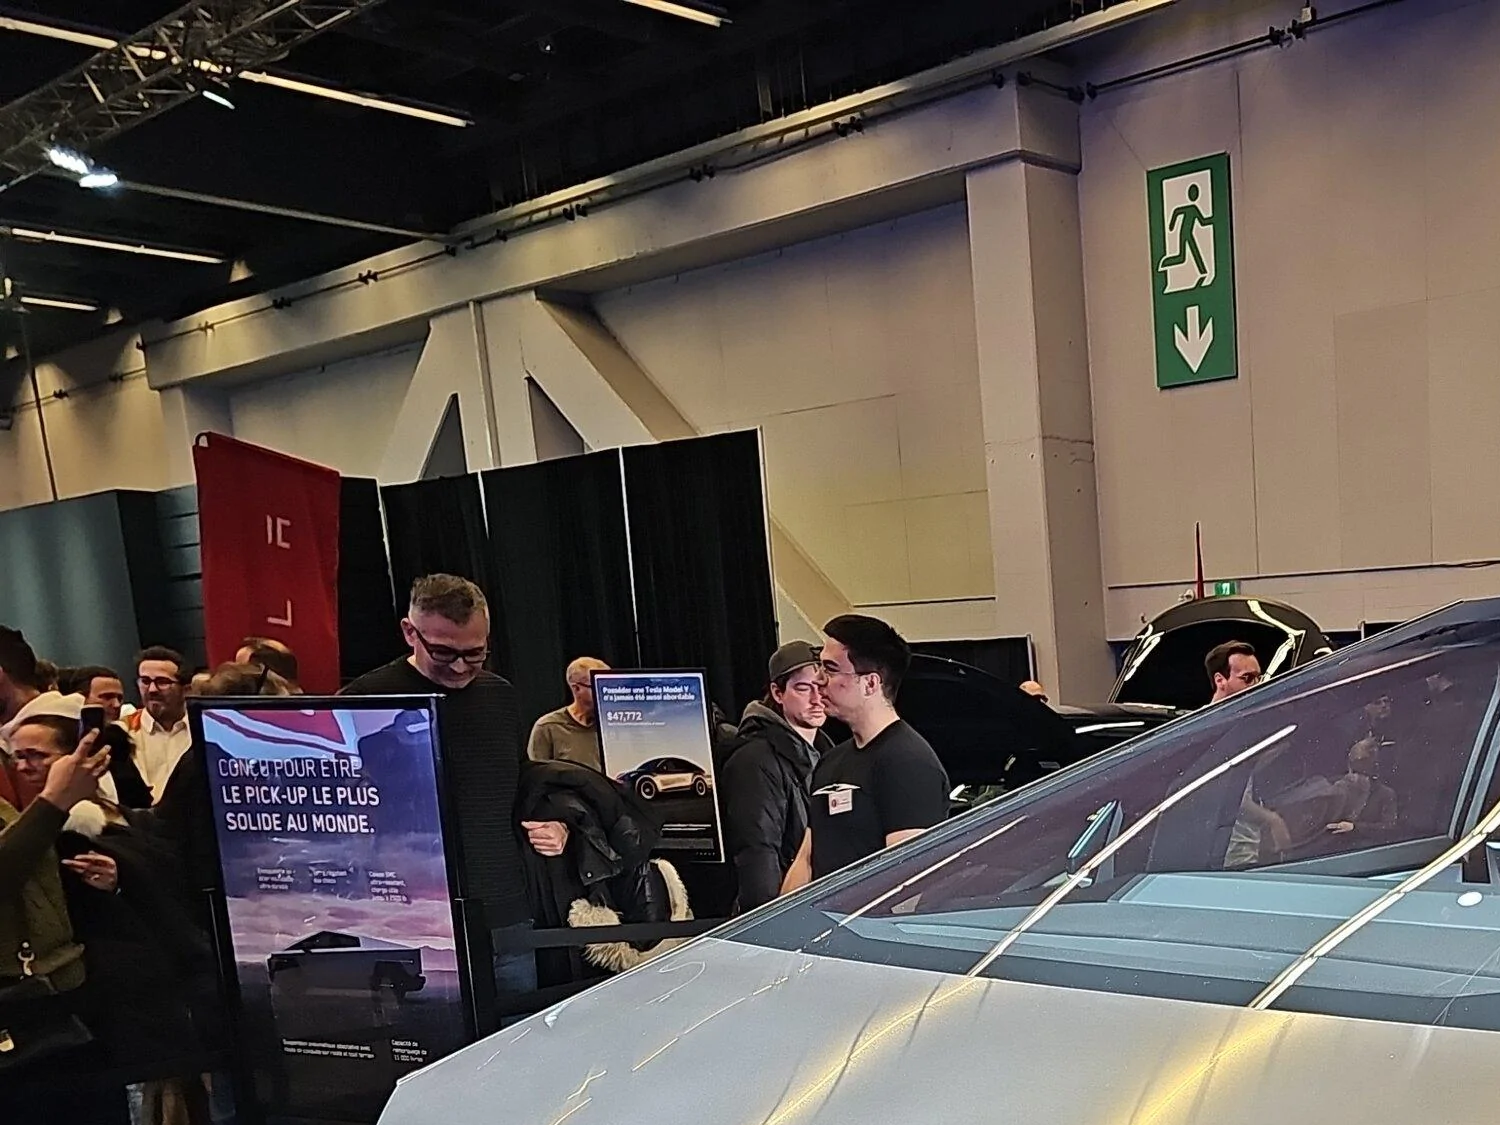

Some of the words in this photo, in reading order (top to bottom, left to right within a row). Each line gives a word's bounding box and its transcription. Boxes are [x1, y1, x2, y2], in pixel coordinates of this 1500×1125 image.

[663, 685, 683, 693] Model
[607, 711, 643, 722] $47,772
[218, 758, 270, 780] CONÇU
[274, 759, 316, 777] POUR
[222, 785, 241, 804] LE
[245, 785, 308, 804] PICK-UP
[312, 786, 333, 805] LE
[336, 786, 380, 806] PLUS
[225, 812, 283, 831] SOLIDE
[286, 813, 308, 832] AU
[311, 813, 376, 833] MONDE.
